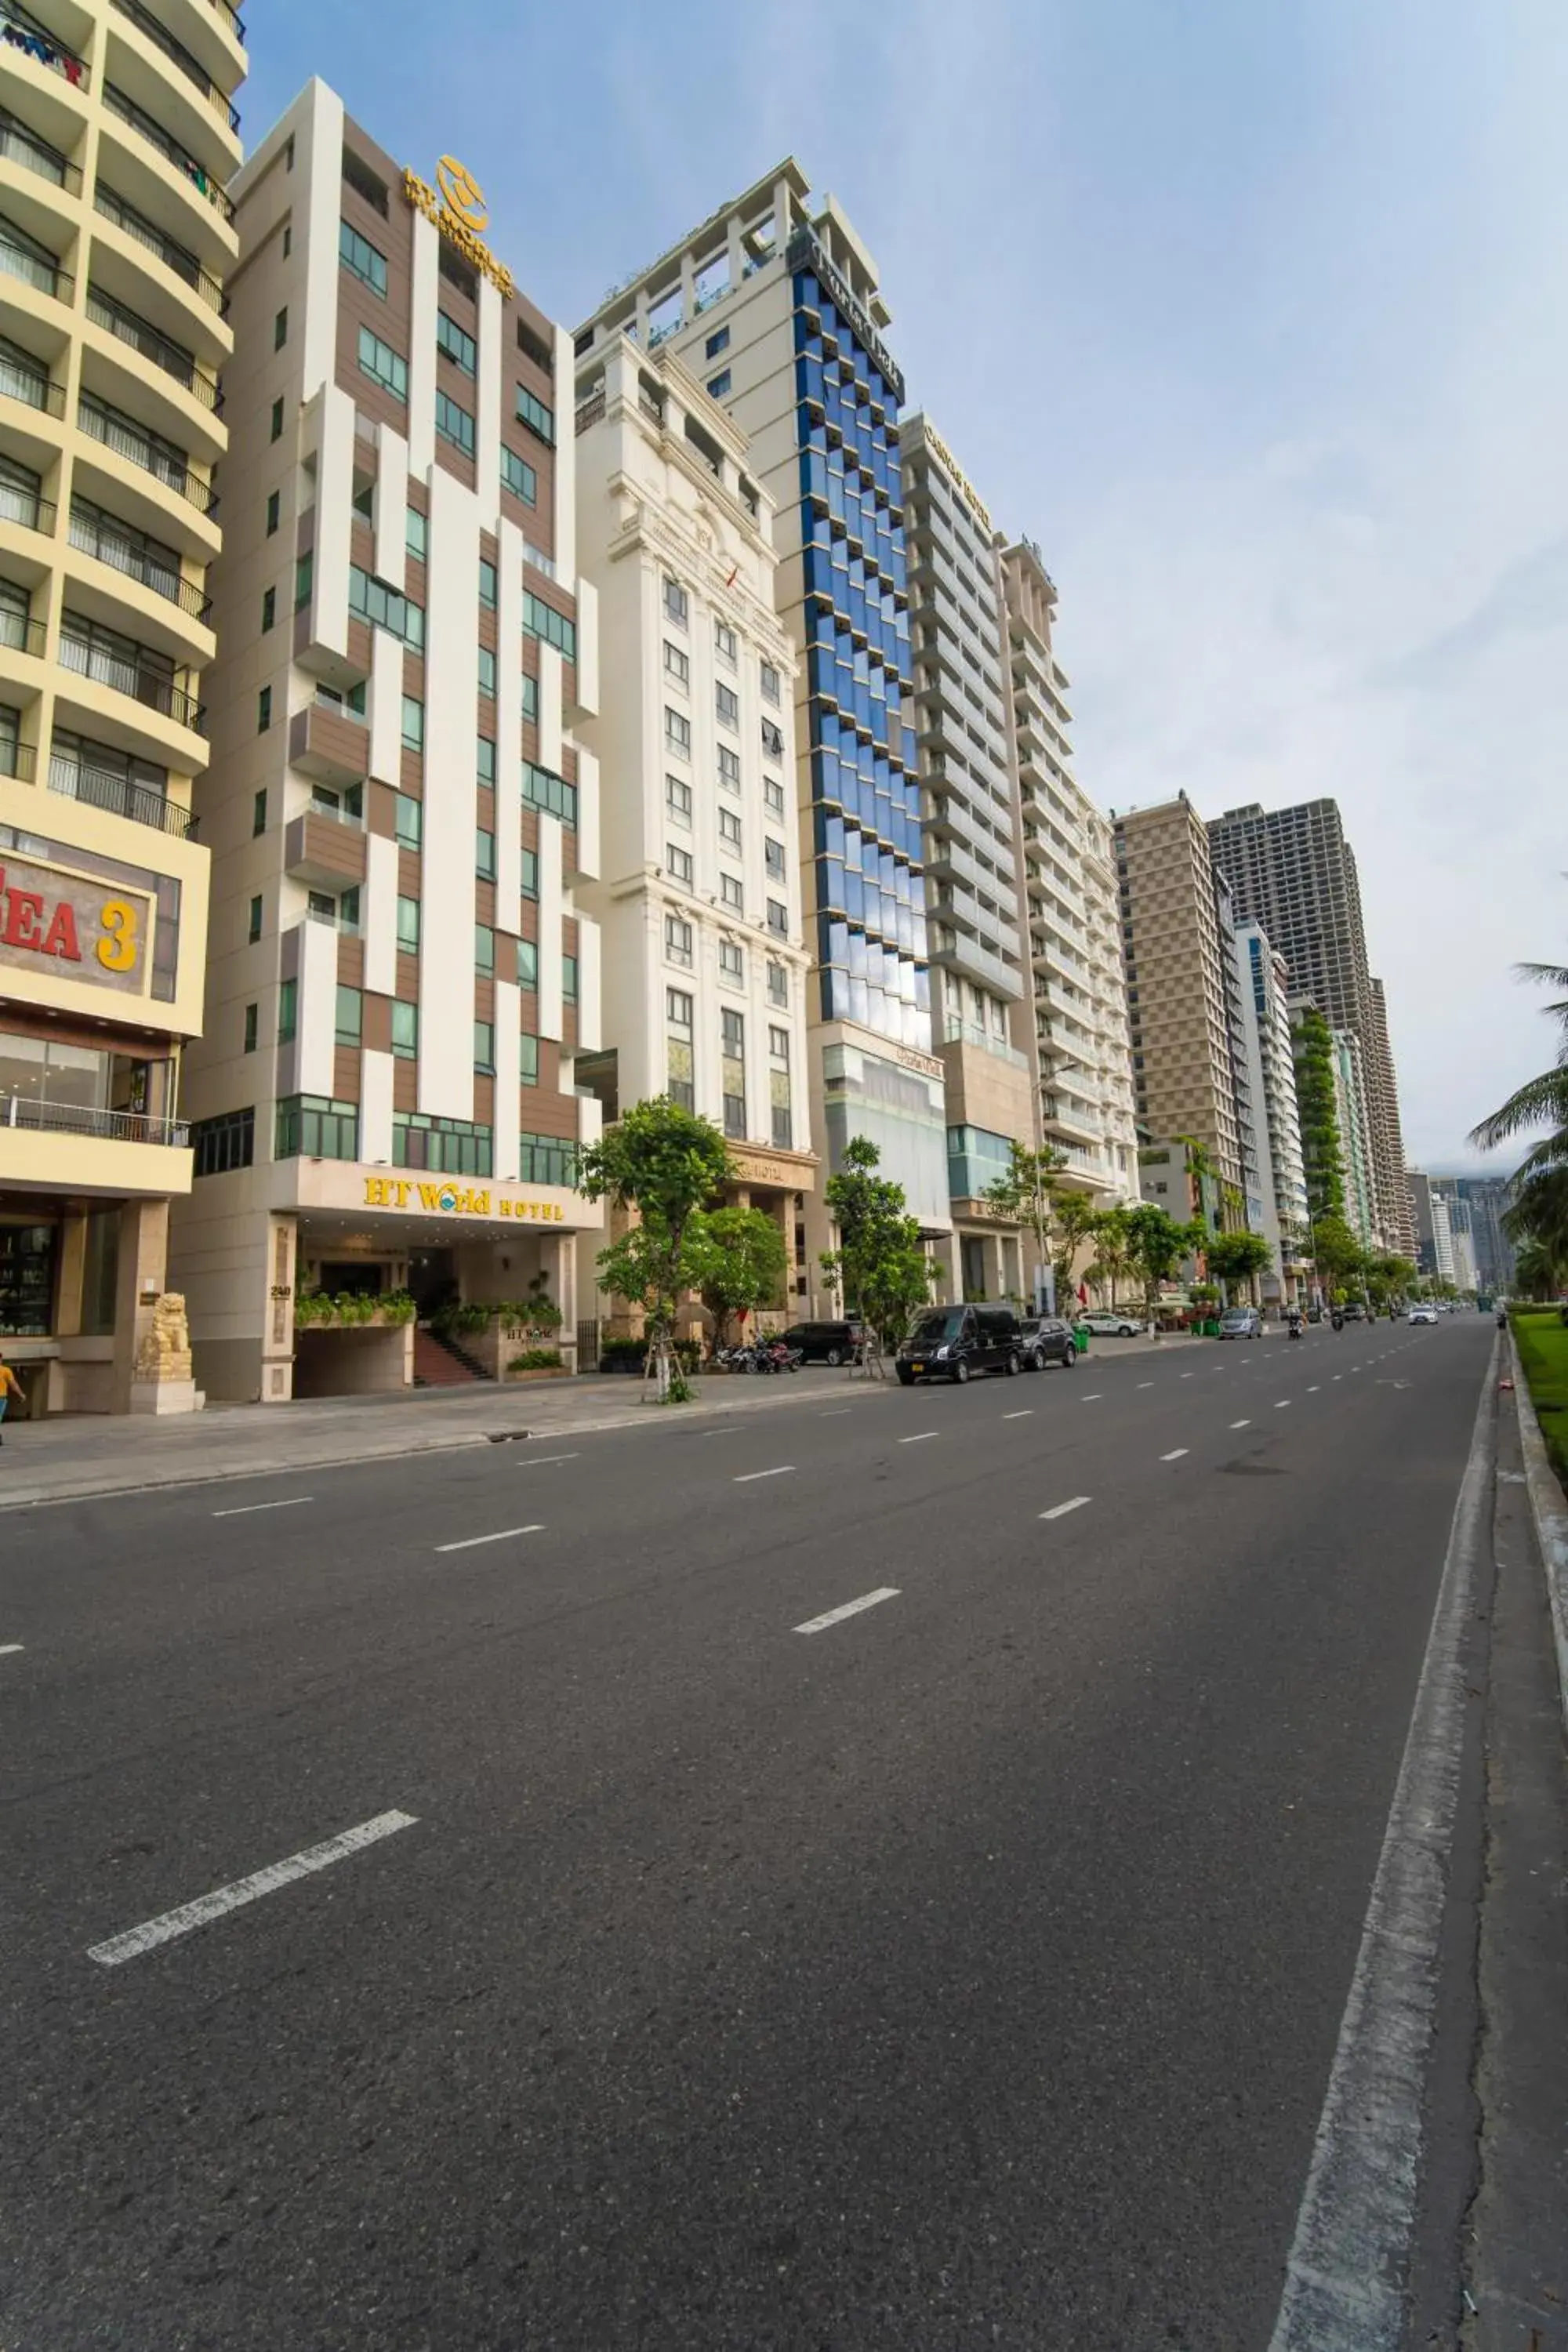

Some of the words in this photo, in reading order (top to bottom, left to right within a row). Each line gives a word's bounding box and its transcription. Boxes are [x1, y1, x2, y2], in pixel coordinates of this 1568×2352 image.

[0, 866, 82, 962] EA
[96, 898, 137, 973] 3
[364, 1177, 412, 1208] HT
[499, 1198, 566, 1221] HOTEL
